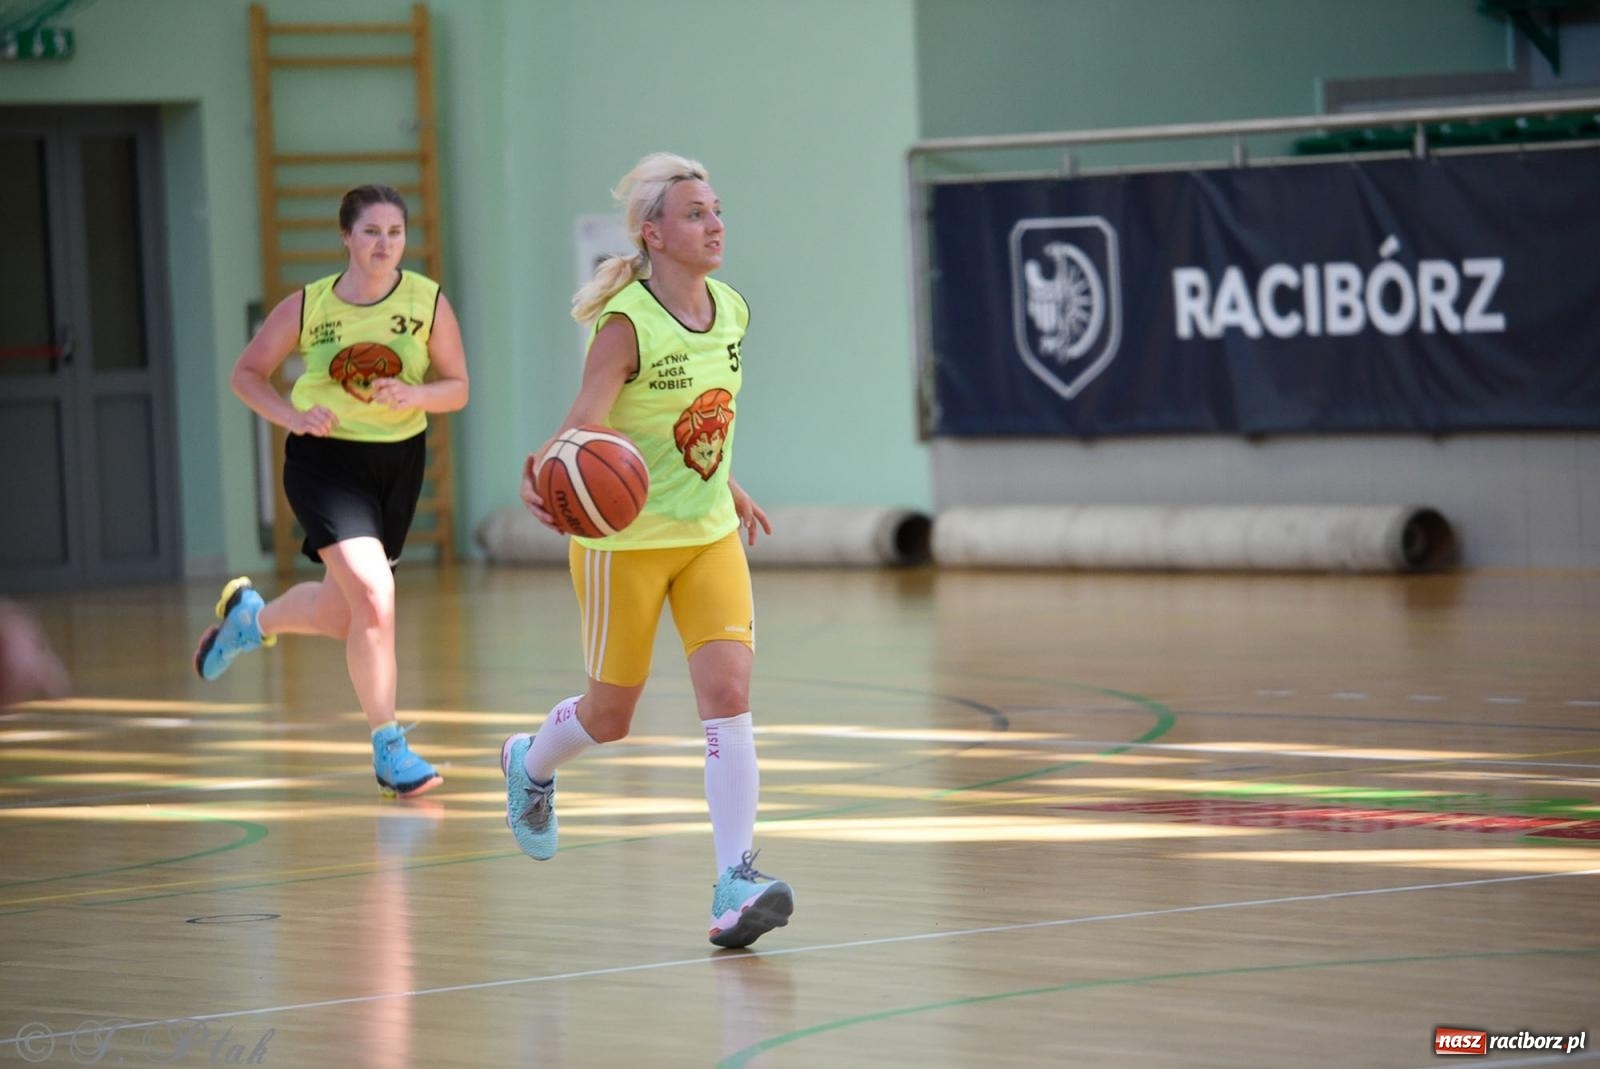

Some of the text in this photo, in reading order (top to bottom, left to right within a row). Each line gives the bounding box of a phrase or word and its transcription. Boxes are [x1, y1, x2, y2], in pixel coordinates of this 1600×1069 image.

[1172, 234, 1506, 340] RACIBÓRZ
[391, 314, 424, 336] 37
[658, 366, 686, 377] LIGA
[649, 377, 693, 390] KOBIET
